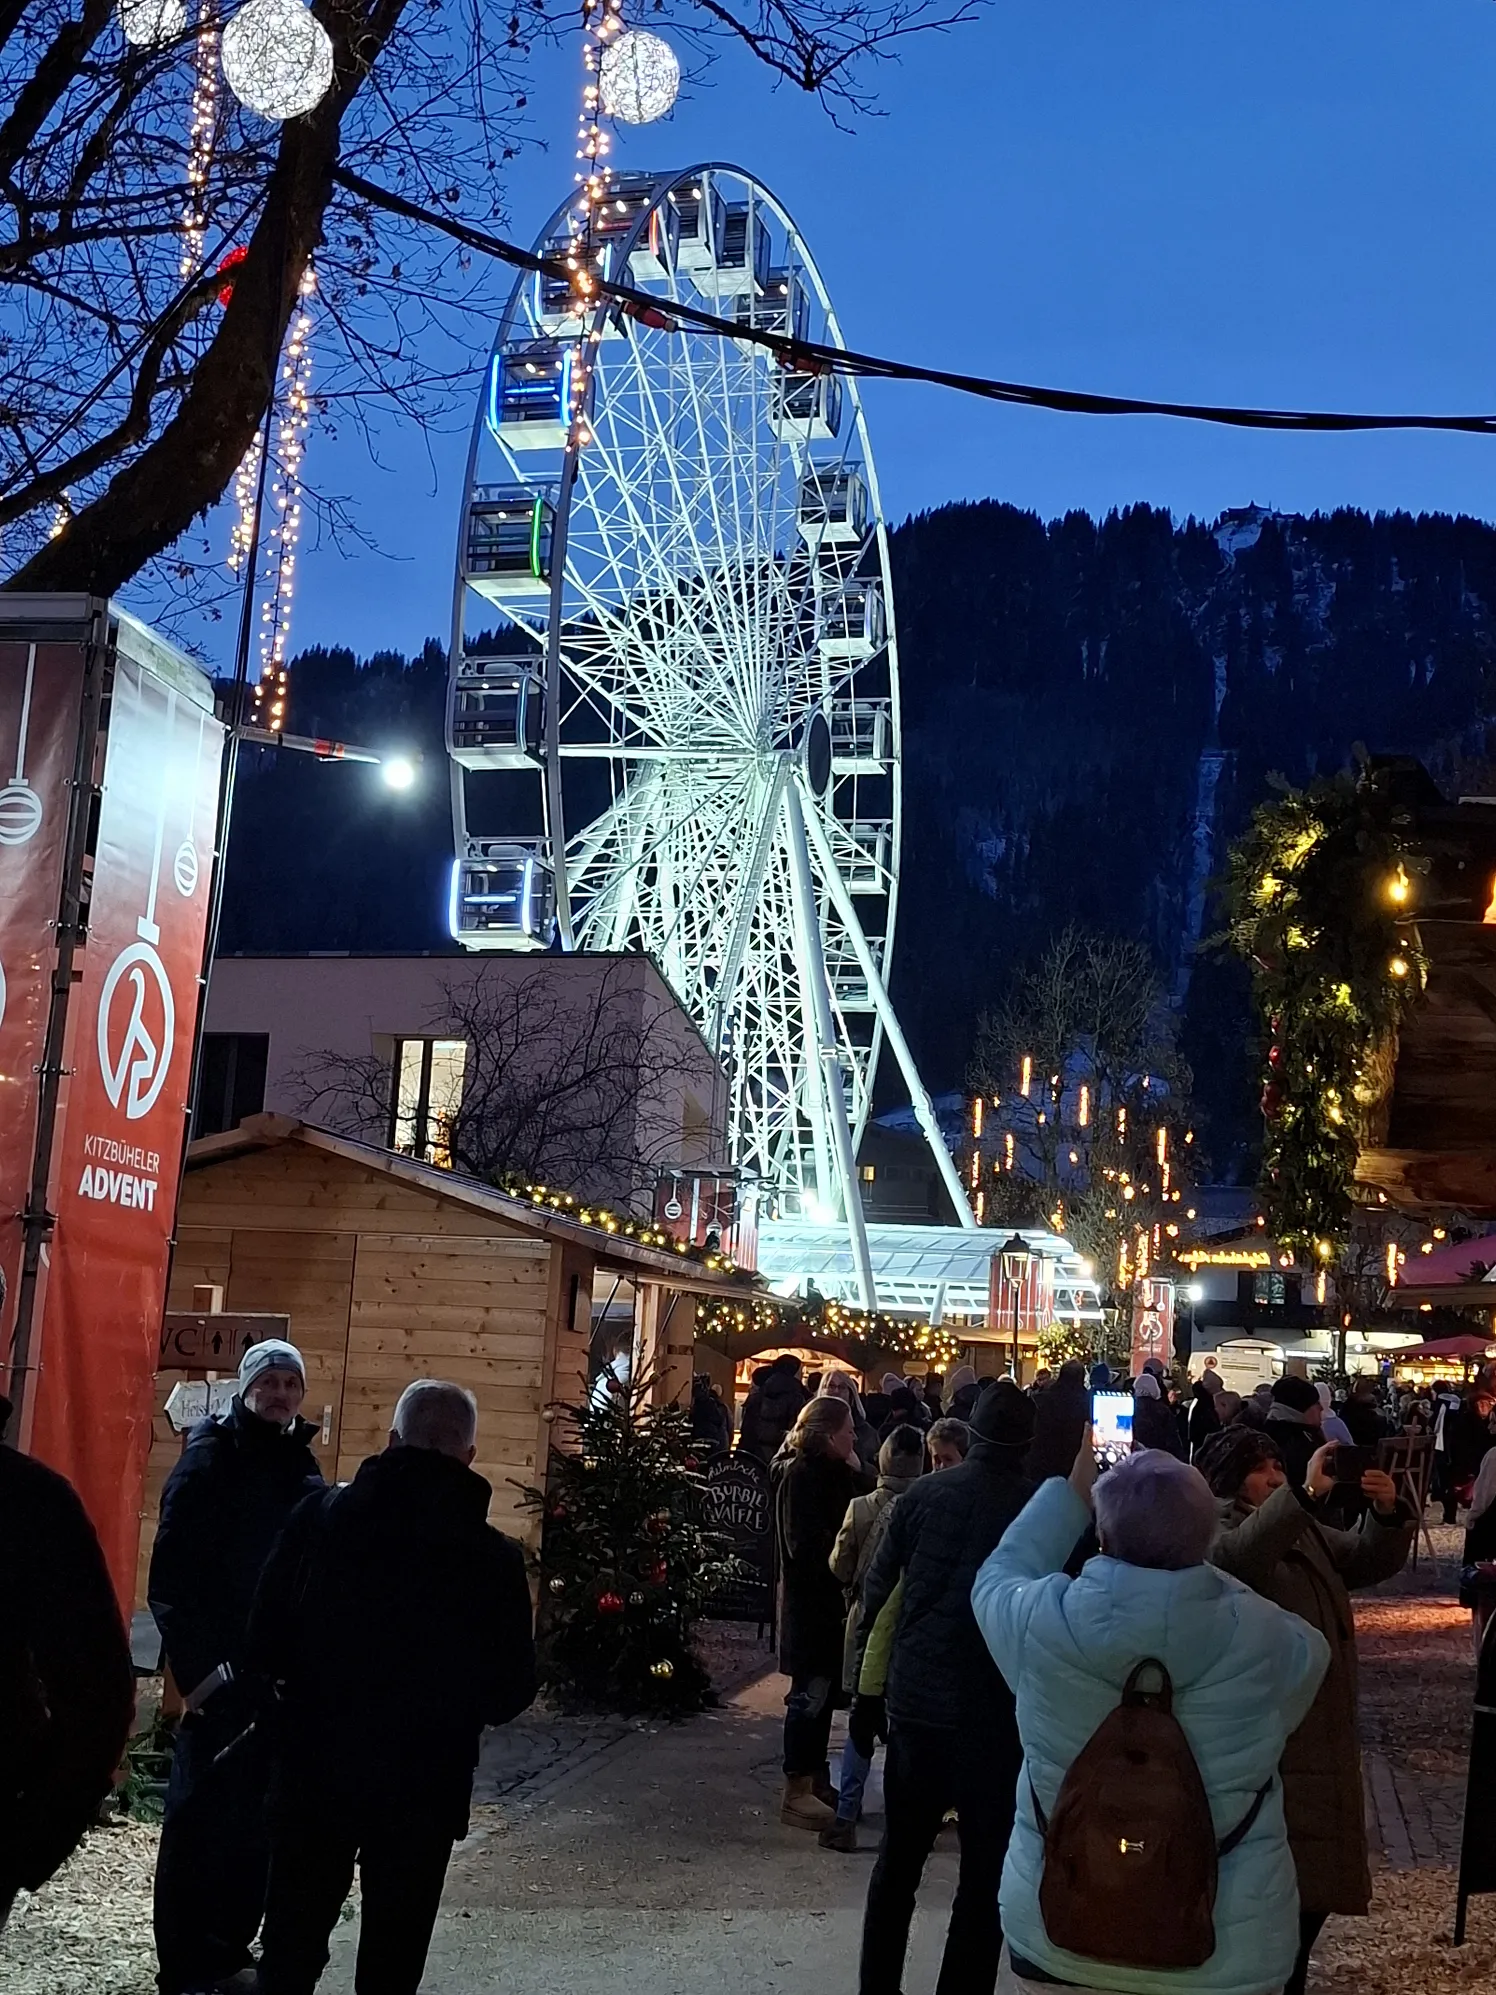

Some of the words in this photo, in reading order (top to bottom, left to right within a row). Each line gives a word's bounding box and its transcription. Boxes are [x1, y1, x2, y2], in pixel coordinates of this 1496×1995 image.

[84, 1133, 160, 1175] KITZBÜHELER
[78, 1164, 158, 1212] ADVENT
[711, 1485, 764, 1508] BUBBLE
